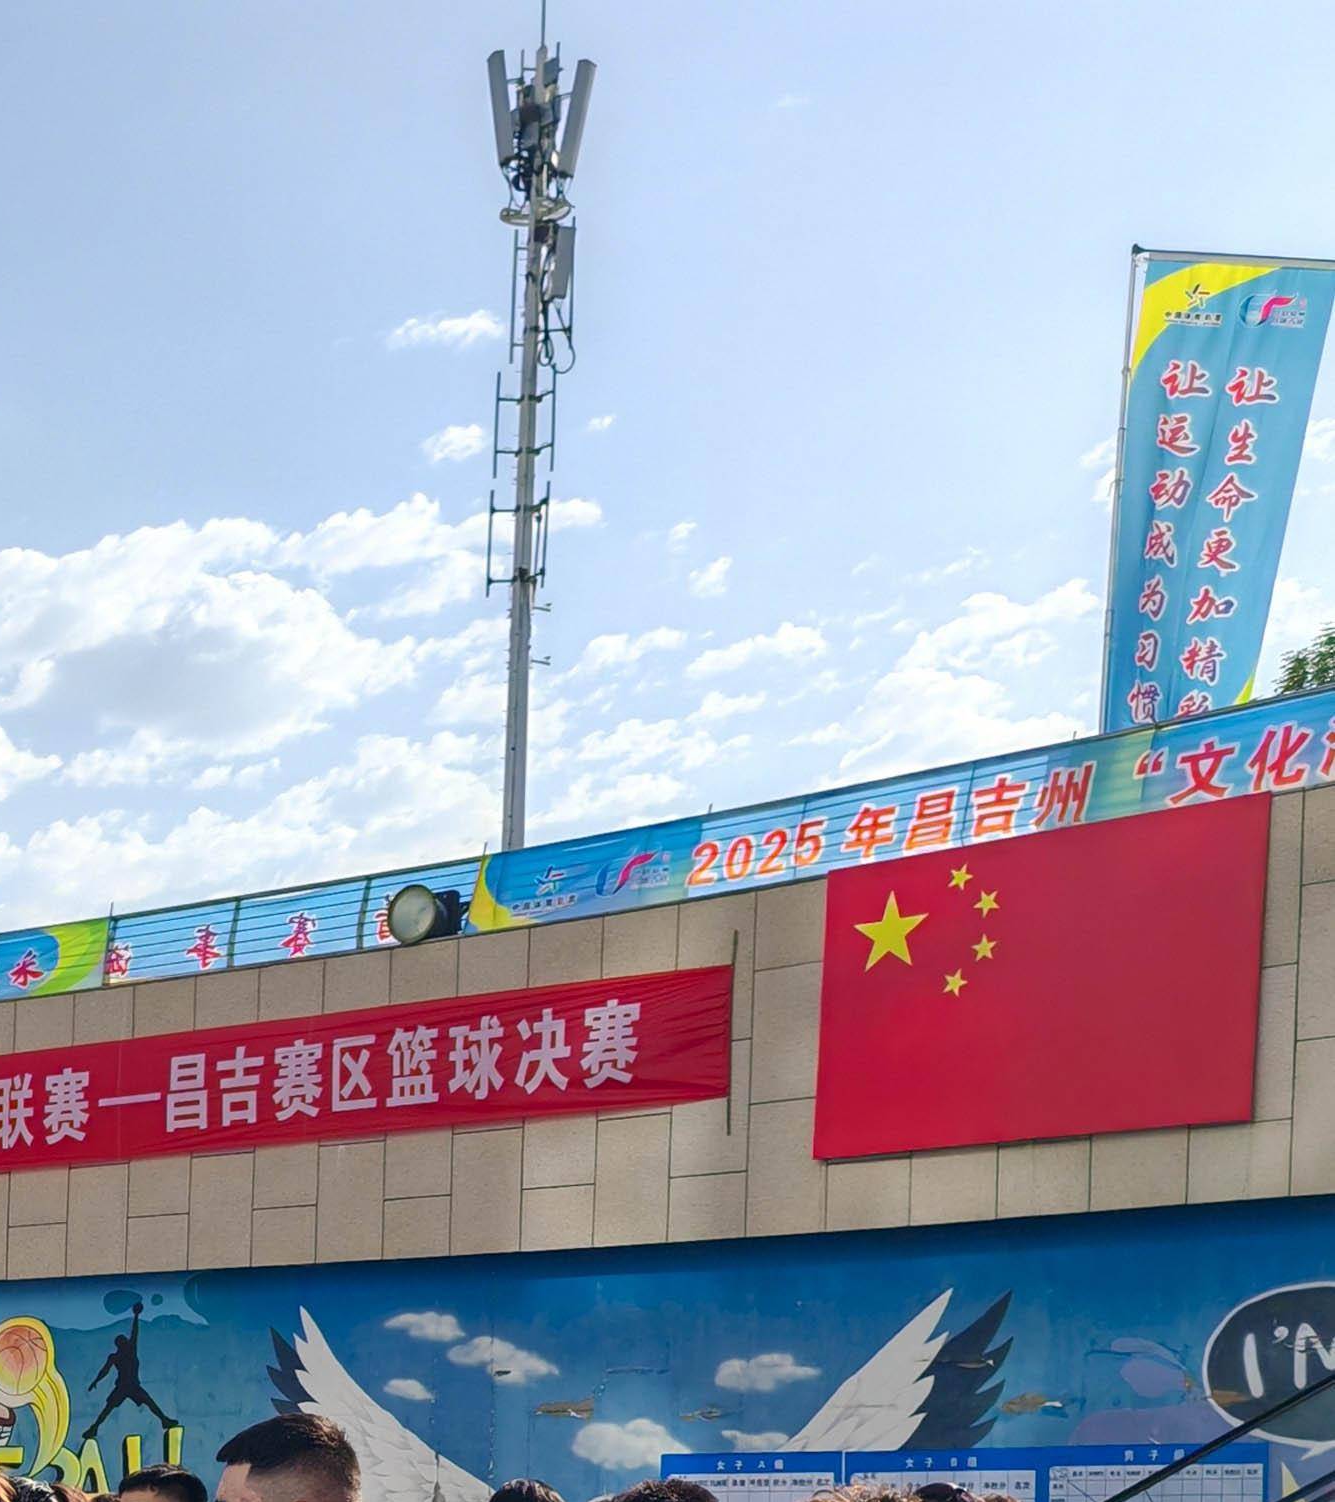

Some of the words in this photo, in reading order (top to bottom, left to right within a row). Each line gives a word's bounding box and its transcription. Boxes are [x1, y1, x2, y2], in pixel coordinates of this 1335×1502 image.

[1128, 360, 1214, 724] 让运动成为习惯
[1173, 367, 1279, 720] 让生命更加精彩
[685, 825, 825, 890] 2025
[840, 760, 1095, 862] 年昌吉州
[1134, 716, 1335, 806] “文化
